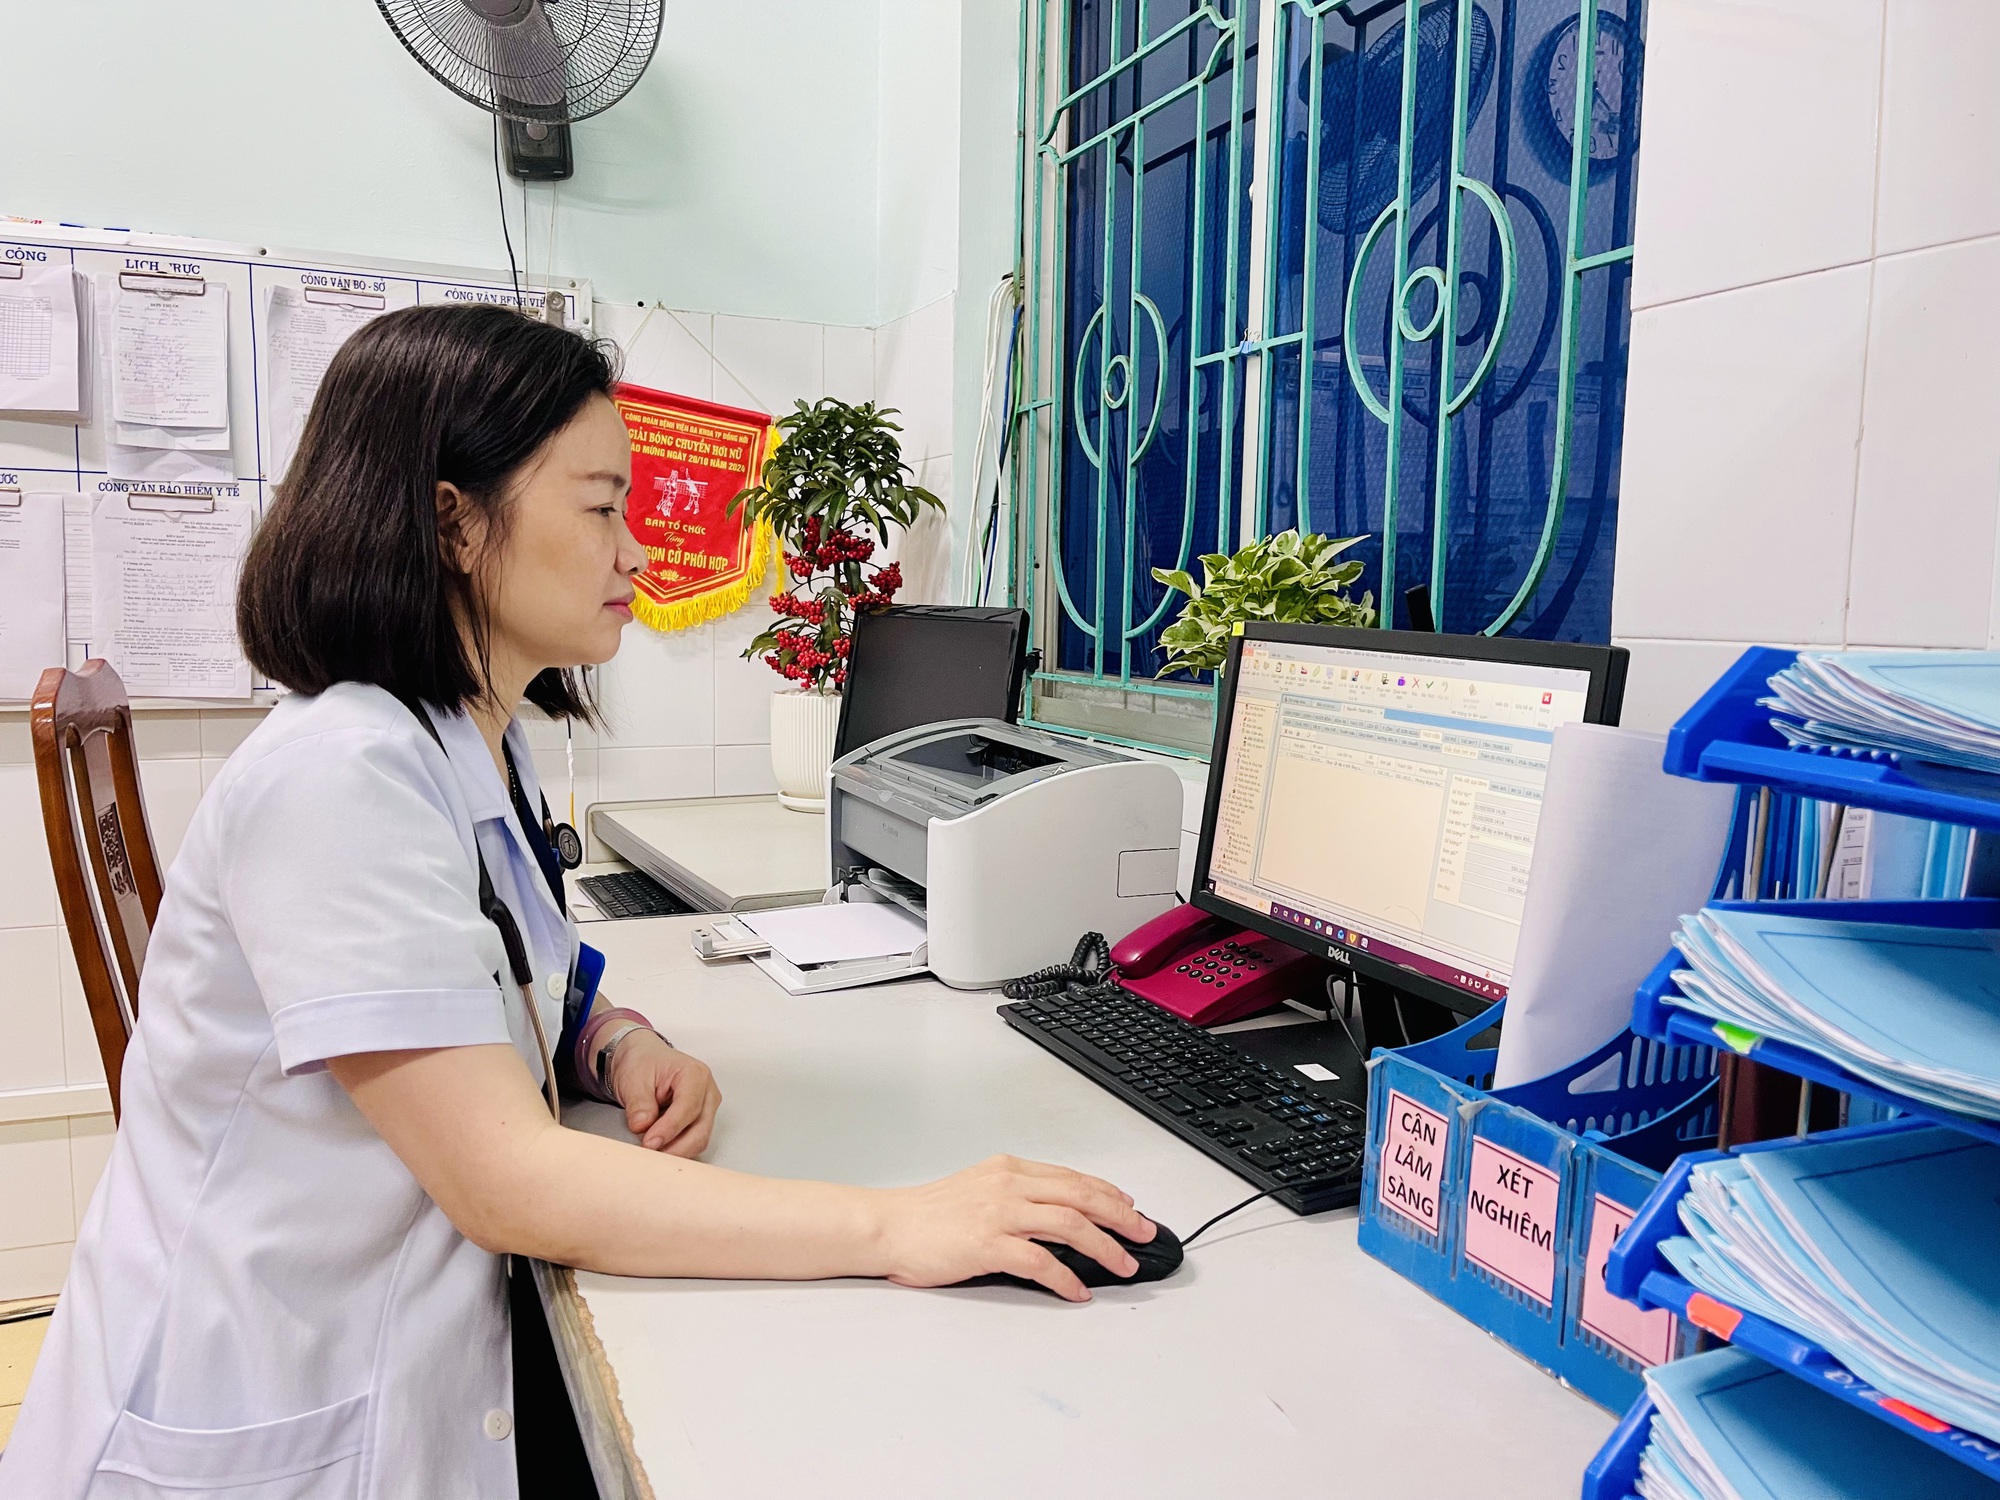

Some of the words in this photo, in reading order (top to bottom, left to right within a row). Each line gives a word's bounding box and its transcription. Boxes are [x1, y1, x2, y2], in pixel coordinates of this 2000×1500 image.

[5, 246, 47, 262] CÔNG
[169, 262, 201, 277] RỰC
[300, 272, 328, 287] CÔNG
[625, 413, 641, 423] CÔNG
[698, 427, 713, 437] KHOA
[715, 431, 722, 439] TP
[628, 426, 647, 441] GIẢI
[649, 432, 674, 446] BÓNG
[712, 444, 727, 458] HƠI
[667, 449, 687, 462] NGÀY
[688, 454, 709, 466] 20/10
[728, 462, 746, 473] 2024
[98, 480, 129, 492] CÔNG
[132, 481, 155, 493] VĂN
[216, 487, 223, 497] Y
[226, 483, 240, 497] TẾ
[645, 517, 665, 528] BAN
[682, 524, 706, 535] CHỨC
[668, 547, 682, 565] CỜ
[683, 550, 706, 569] PHỐI
[708, 555, 729, 574] HỢP
[1327, 945, 1350, 965] DELL
[1401, 1112, 1436, 1146] CẬN
[1395, 1144, 1432, 1182] LÂM
[1496, 1164, 1534, 1199] XÉT
[1388, 1175, 1434, 1218] SÀNG
